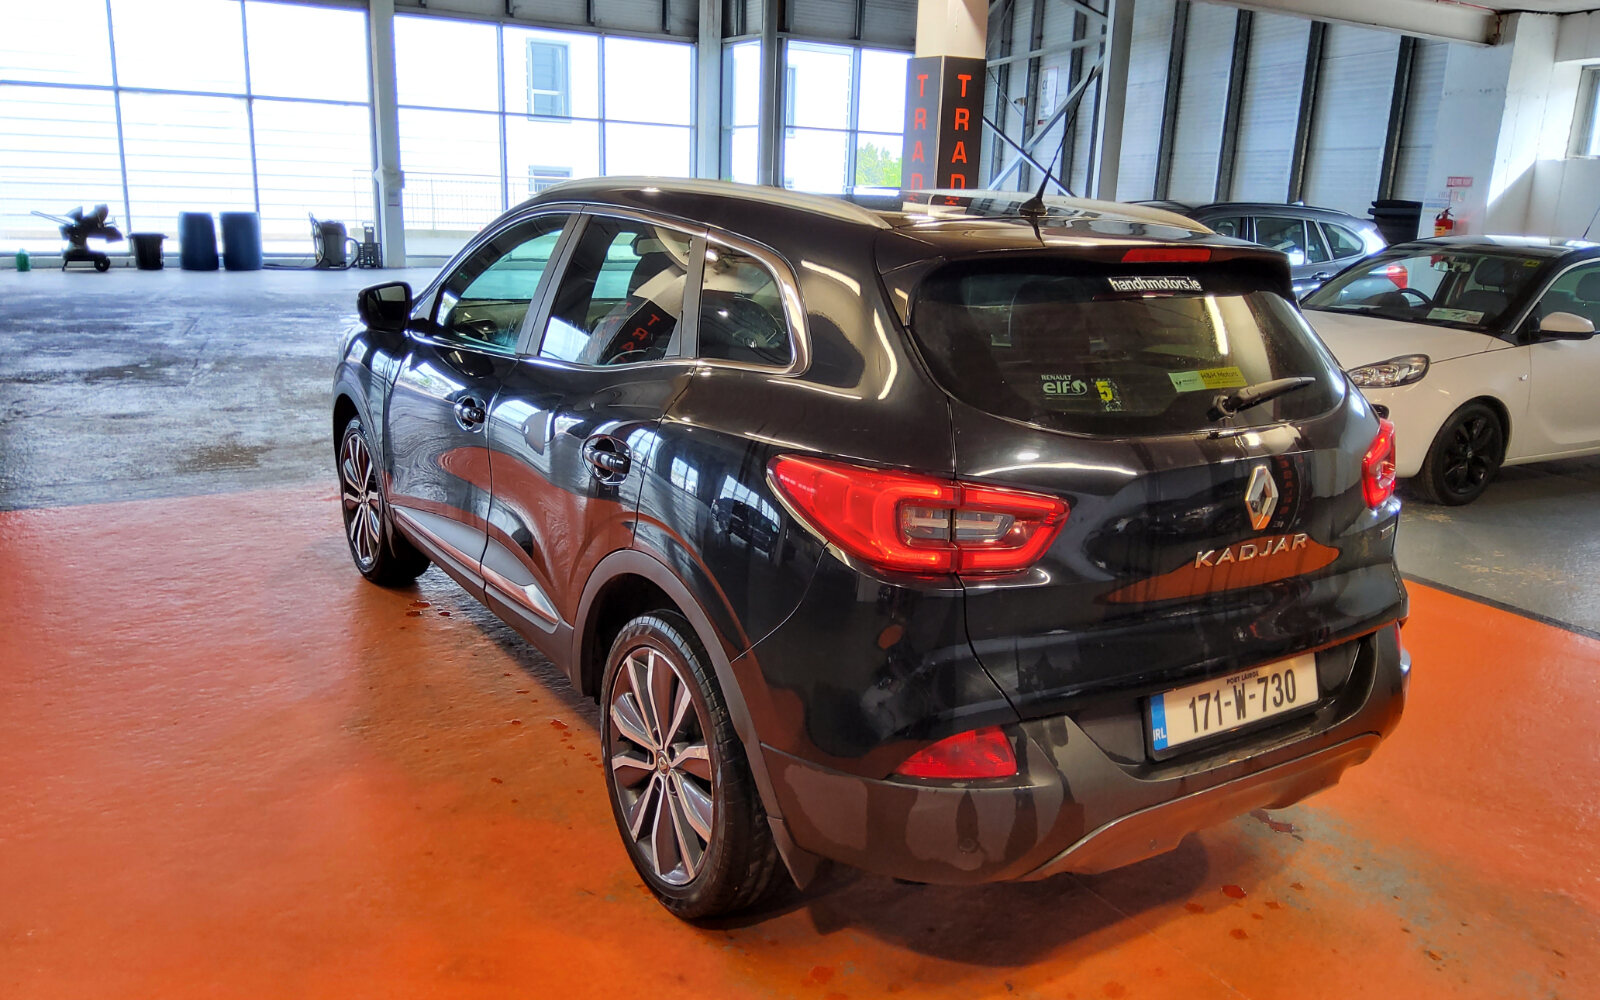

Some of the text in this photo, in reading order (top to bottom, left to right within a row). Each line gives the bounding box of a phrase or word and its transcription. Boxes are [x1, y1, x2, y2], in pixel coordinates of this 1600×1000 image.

[1108, 276, 1203, 291] handhmotors.ie
[1043, 381, 1070, 394] elf
[1096, 381, 1113, 402] 5
[1195, 533, 1307, 568] KADJAR
[1189, 669, 1296, 733] 171-W-730
[1153, 729, 1167, 741] IRL
